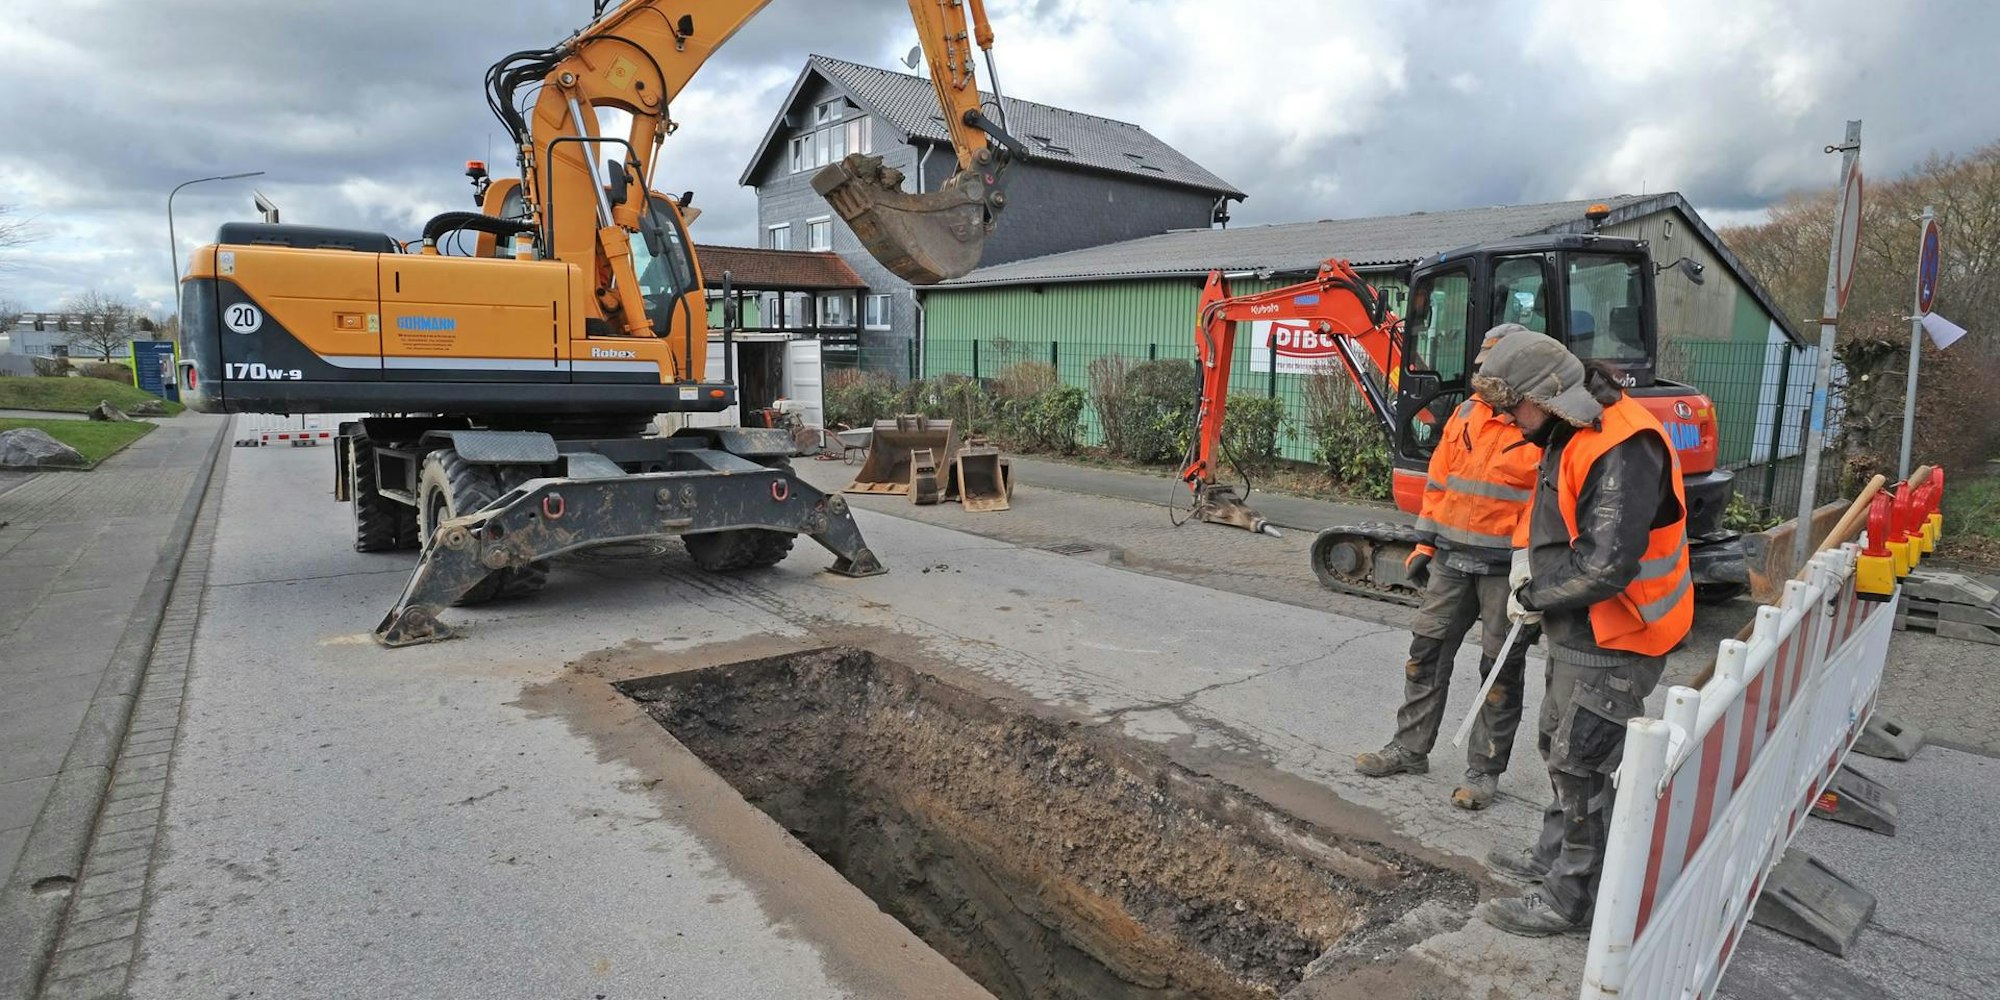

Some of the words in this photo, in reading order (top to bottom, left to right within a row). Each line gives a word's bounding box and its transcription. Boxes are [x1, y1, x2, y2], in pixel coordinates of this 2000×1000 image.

[1251, 303, 1279, 314] Kubota
[233, 307, 255, 327] 20
[591, 347, 636, 358] Robex
